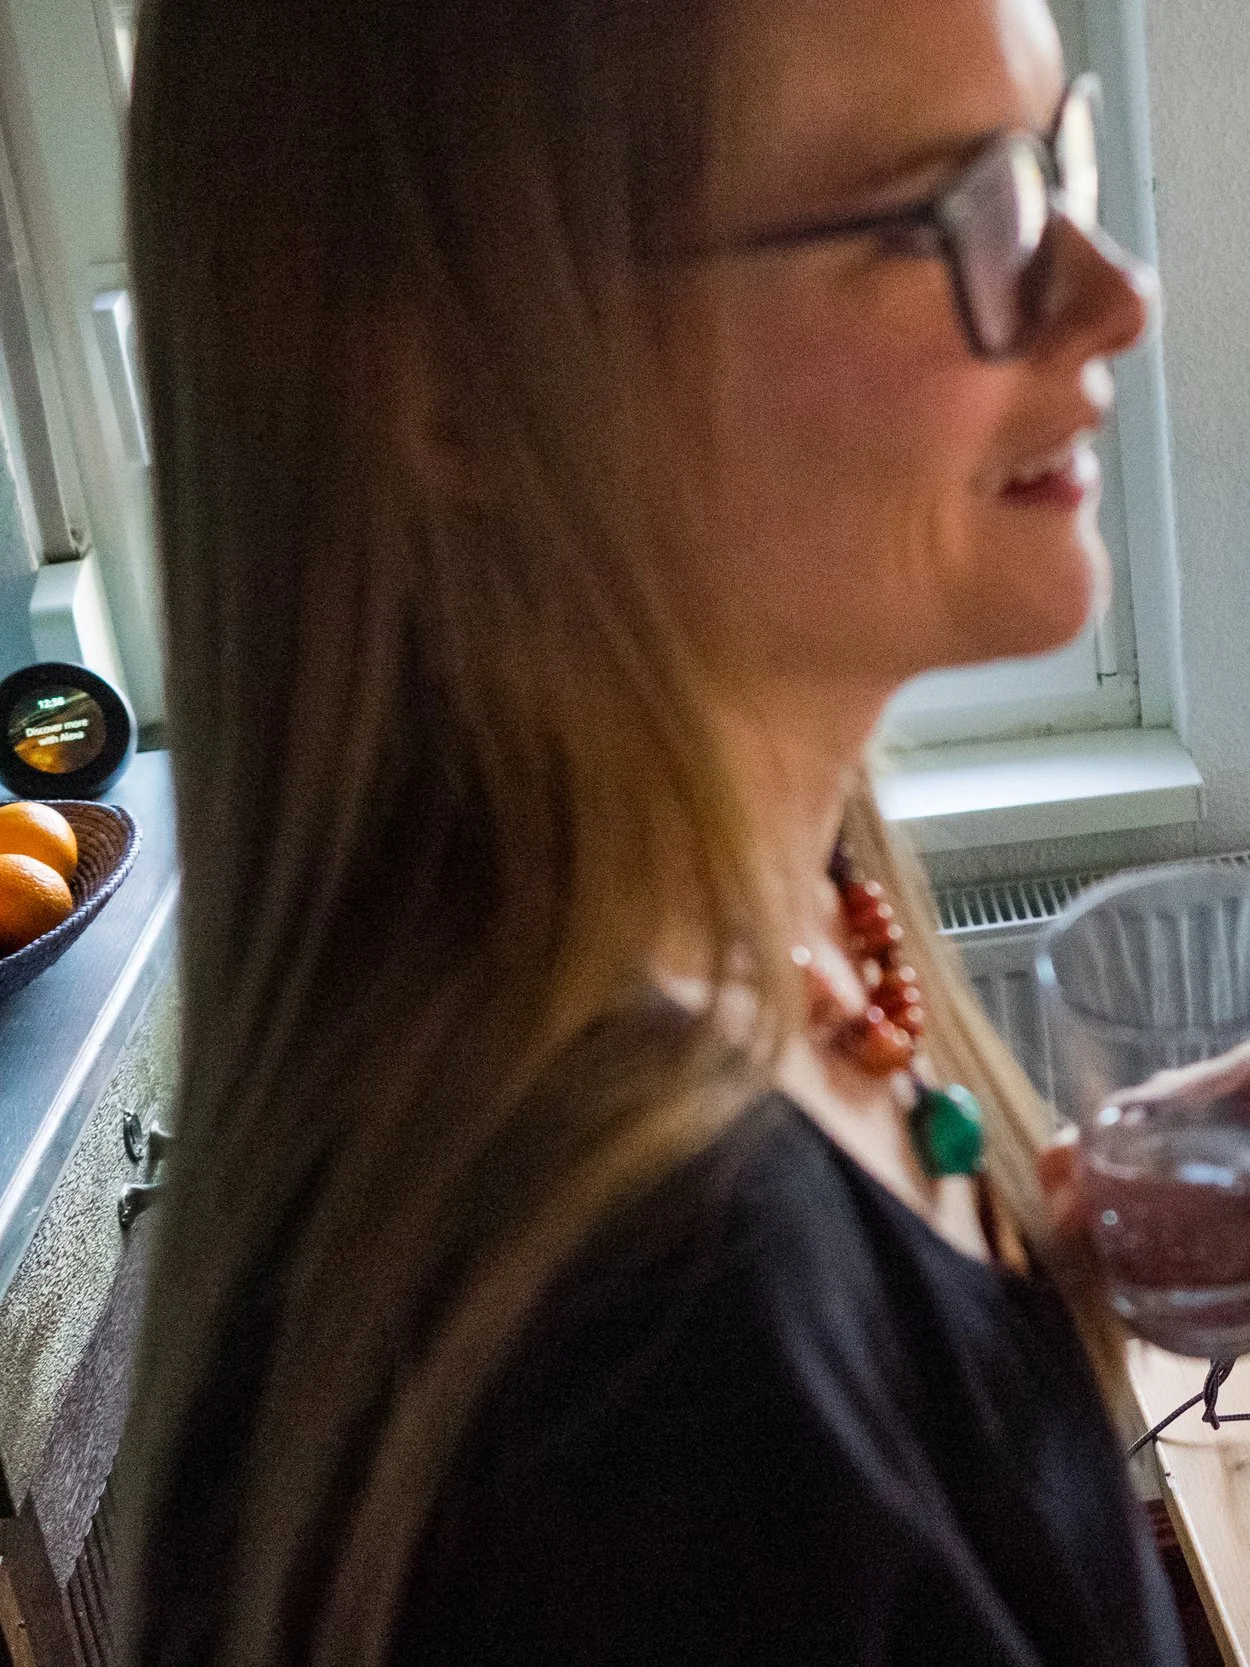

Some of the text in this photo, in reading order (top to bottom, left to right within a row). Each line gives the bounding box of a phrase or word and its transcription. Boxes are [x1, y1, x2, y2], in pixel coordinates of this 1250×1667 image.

[25, 718, 89, 737] Discover more
[38, 730, 86, 746] with Alexa
